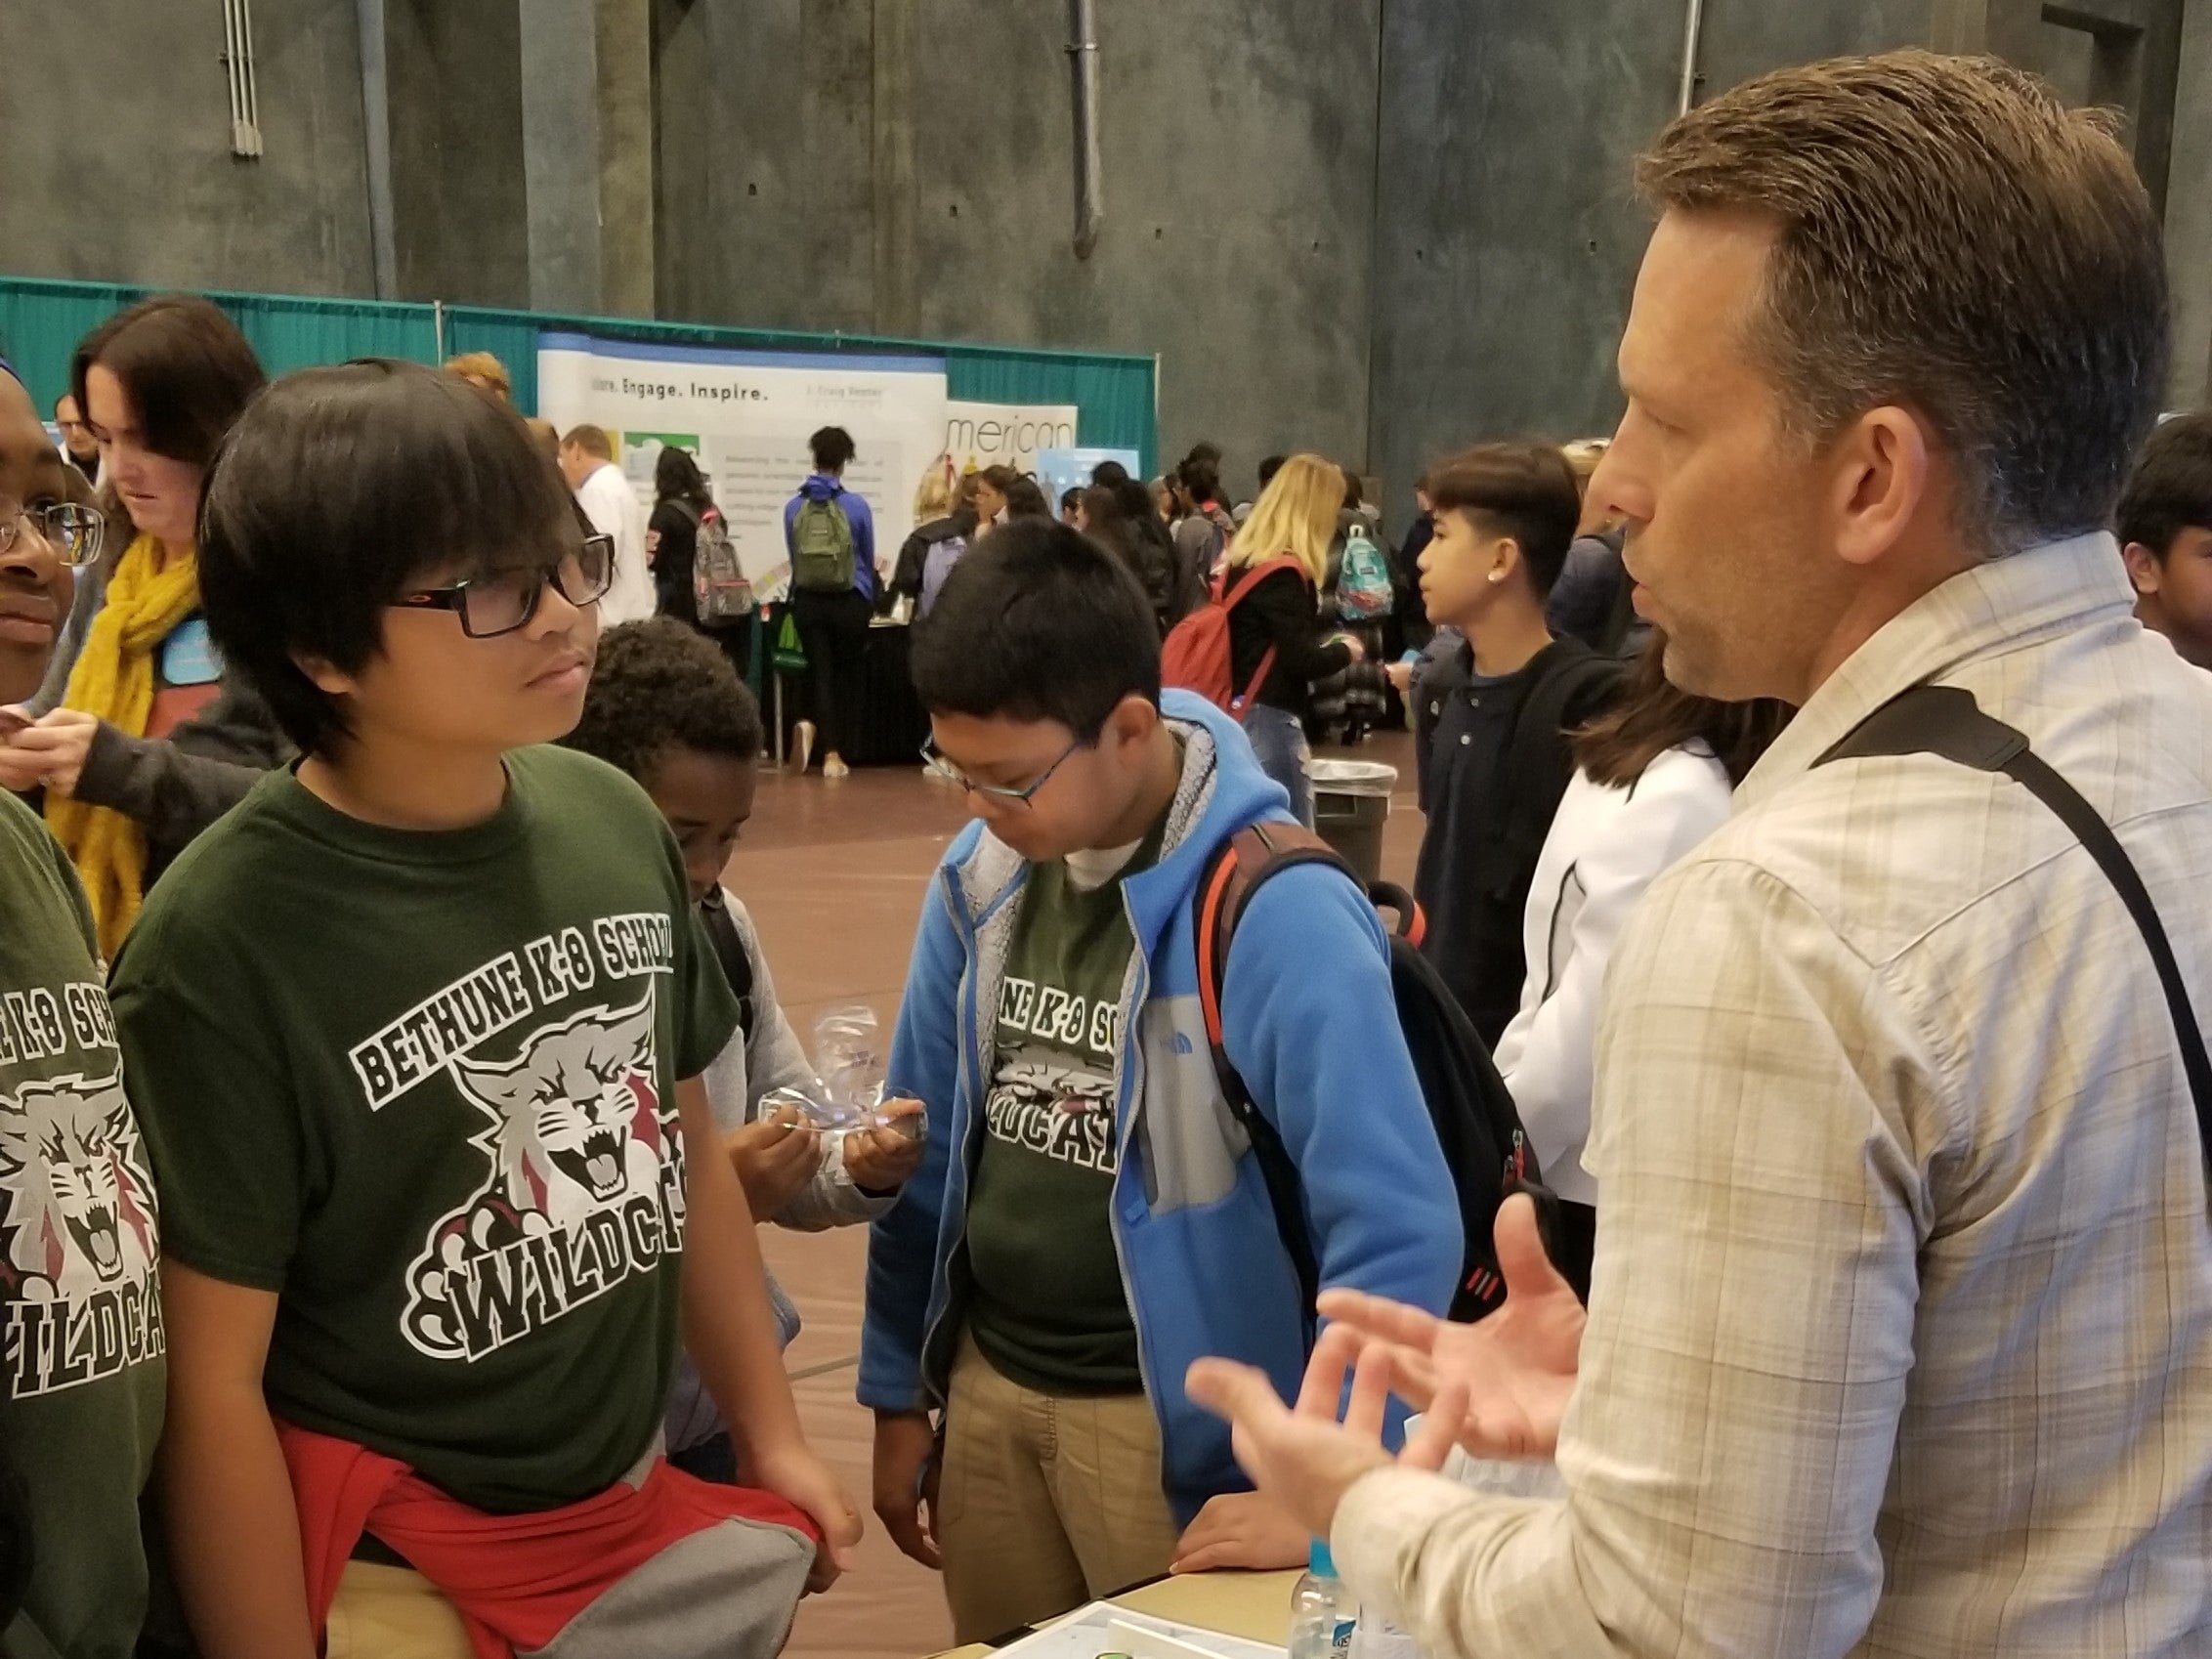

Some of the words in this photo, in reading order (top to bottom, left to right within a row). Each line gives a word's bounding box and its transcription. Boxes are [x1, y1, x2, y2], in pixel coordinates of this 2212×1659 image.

[622, 378, 683, 400] Engage.
[690, 382, 769, 403] Inspire.
[4, 987, 66, 1060] K-8
[349, 951, 533, 1112] BETHUNE
[524, 926, 595, 1005] K-8
